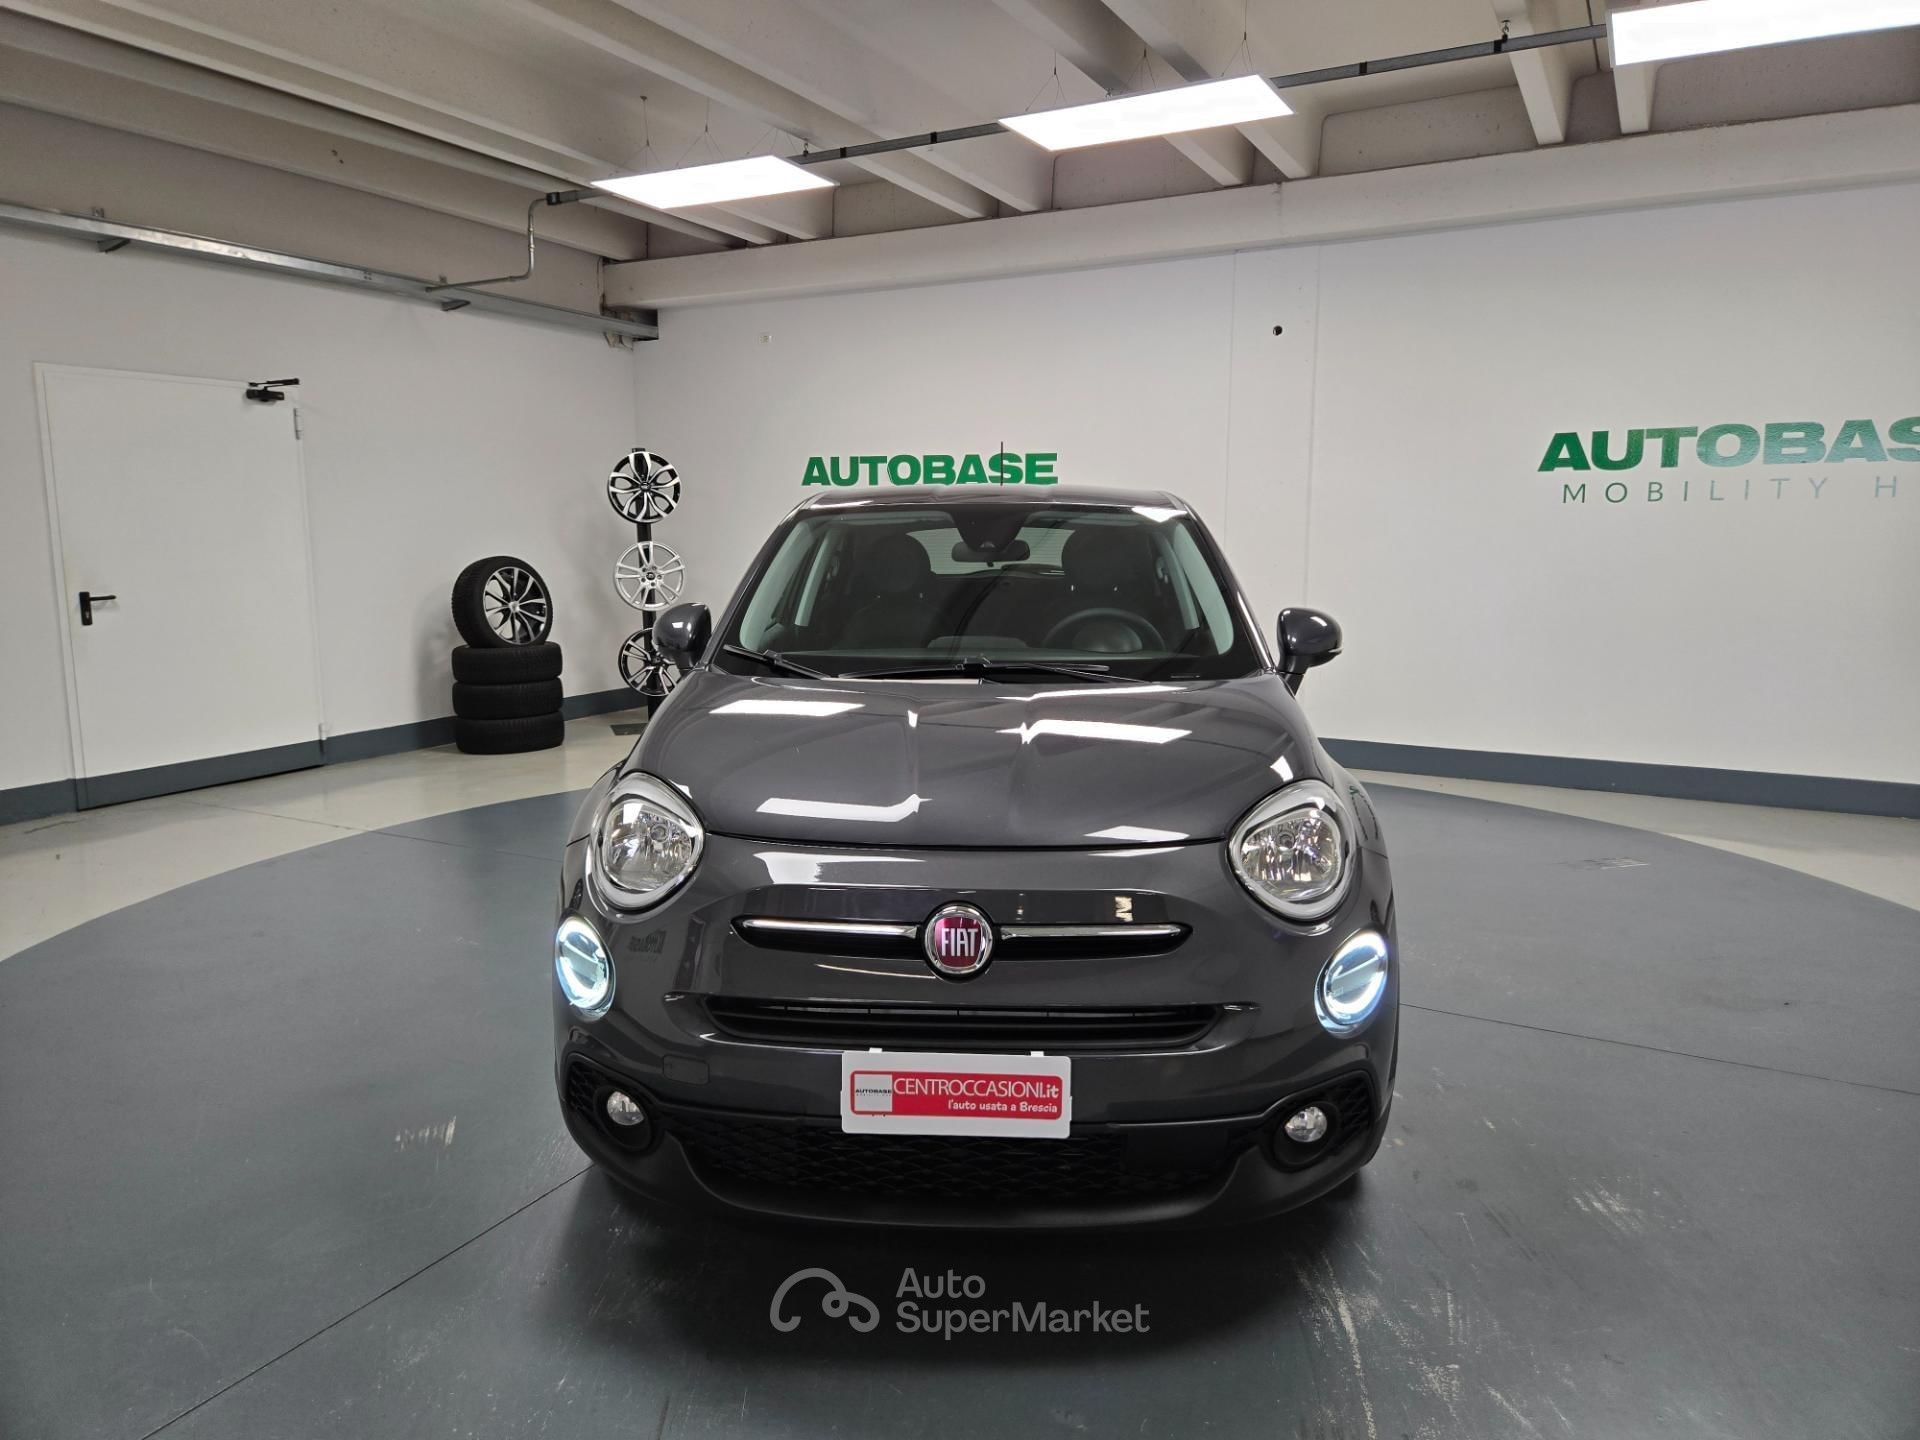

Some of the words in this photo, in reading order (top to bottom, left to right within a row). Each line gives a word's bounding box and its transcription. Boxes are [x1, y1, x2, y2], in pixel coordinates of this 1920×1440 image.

[801, 452, 1058, 486] AUTOBASE
[1562, 477, 1828, 504] MOBILITY
[941, 927, 978, 957] FIAT
[893, 1077, 1059, 1099] CENTROCCASIONI.it
[948, 1100, 976, 1111] l'auto
[979, 1102, 1007, 1112] usata
[1019, 1102, 1058, 1113] Brescia
